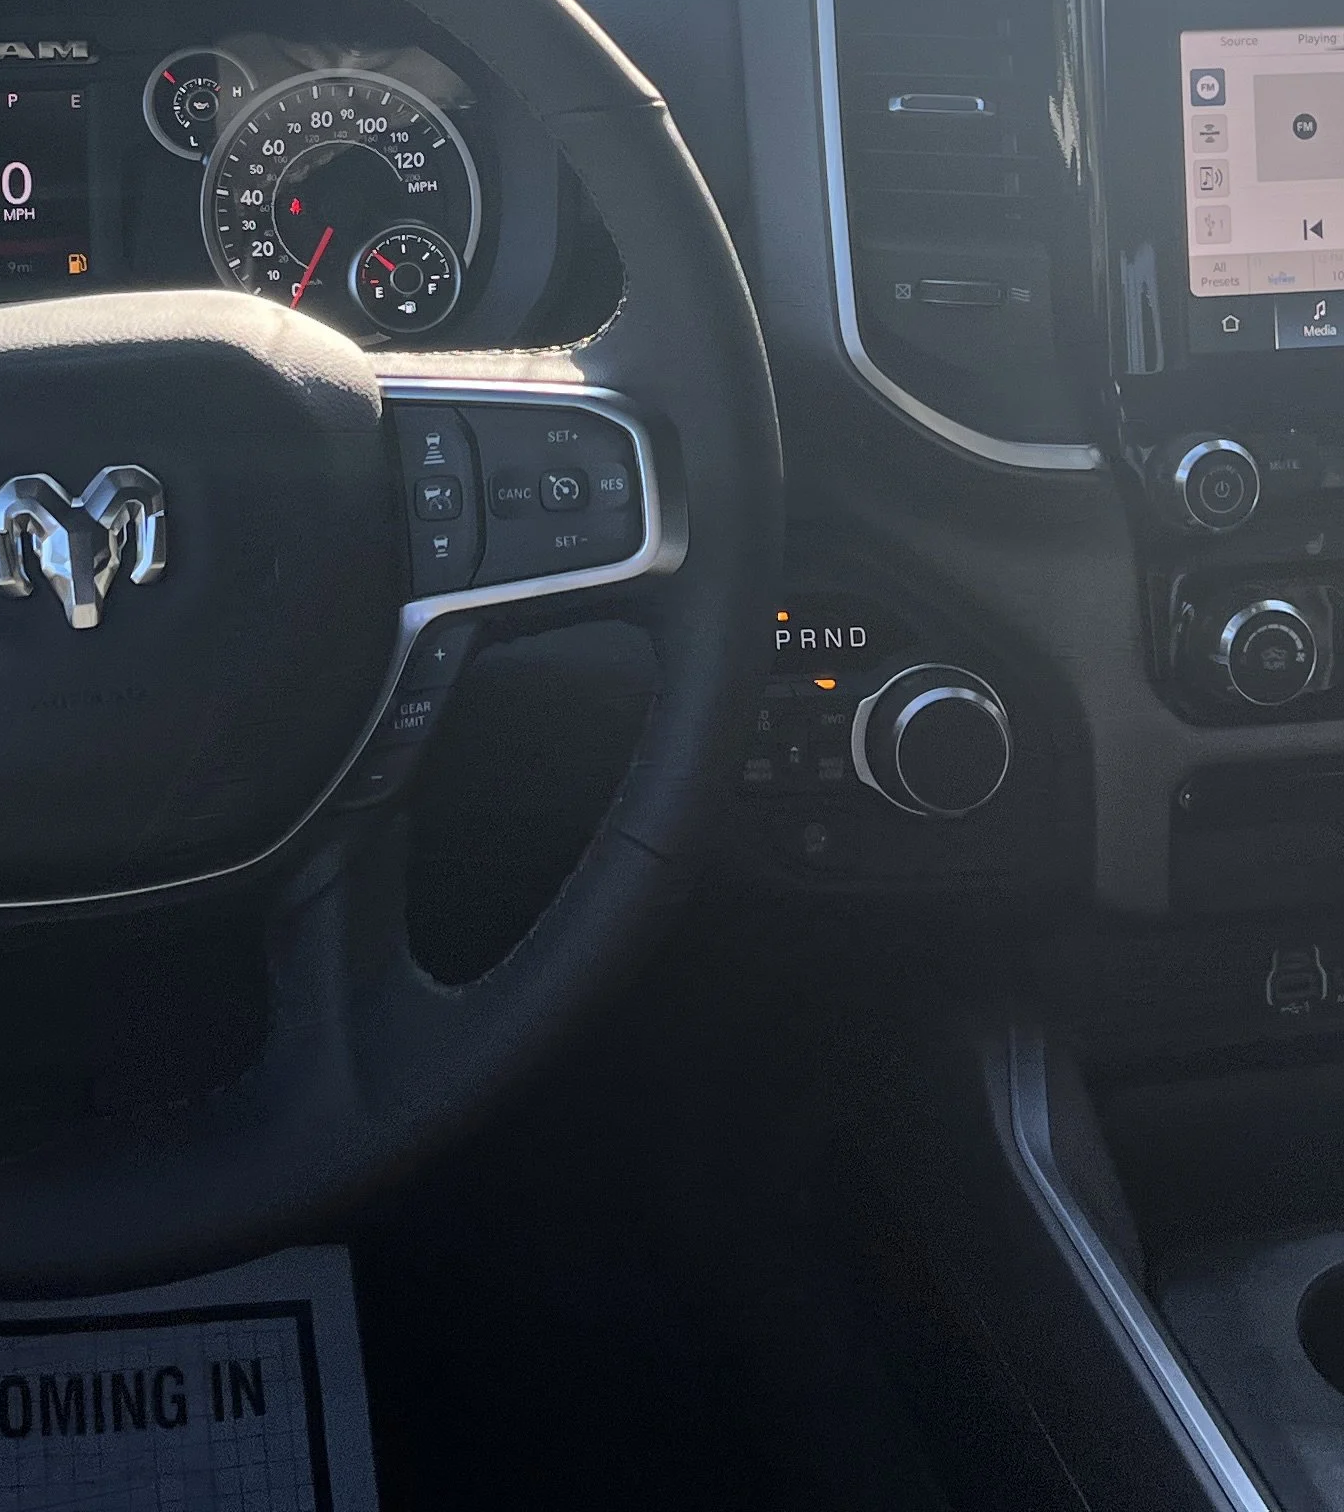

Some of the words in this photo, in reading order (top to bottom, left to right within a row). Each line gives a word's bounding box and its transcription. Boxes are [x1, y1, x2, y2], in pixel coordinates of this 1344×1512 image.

[1220, 35, 1258, 47] Source
[232, 86, 242, 97] H
[1200, 82, 1216, 92] FM
[7, 92, 18, 108] P
[70, 93, 81, 108] E
[310, 111, 333, 129] 80
[340, 108, 355, 120] 90
[286, 123, 302, 134] 70
[356, 117, 388, 134] 100
[1296, 120, 1314, 132] FM
[190, 136, 198, 147] L
[390, 132, 409, 143] 110
[261, 139, 285, 156] 60
[394, 151, 426, 169] 120
[249, 164, 264, 175] 50
[1, 161, 33, 206] 0
[408, 181, 438, 194] MPH
[239, 190, 264, 206] 40
[2, 208, 36, 222] MPH
[241, 220, 256, 231] 30
[251, 241, 274, 257] 20
[1212, 261, 1227, 273] All
[267, 270, 280, 281] 10
[1201, 275, 1240, 288] Presets
[375, 286, 384, 299] E
[428, 284, 437, 295] F
[1303, 324, 1338, 338] Media
[600, 478, 624, 491] RES
[497, 487, 532, 500] CANC
[400, 700, 431, 715] GEAR
[393, 715, 425, 729] LIMIT
[210, 1355, 268, 1422] IN
